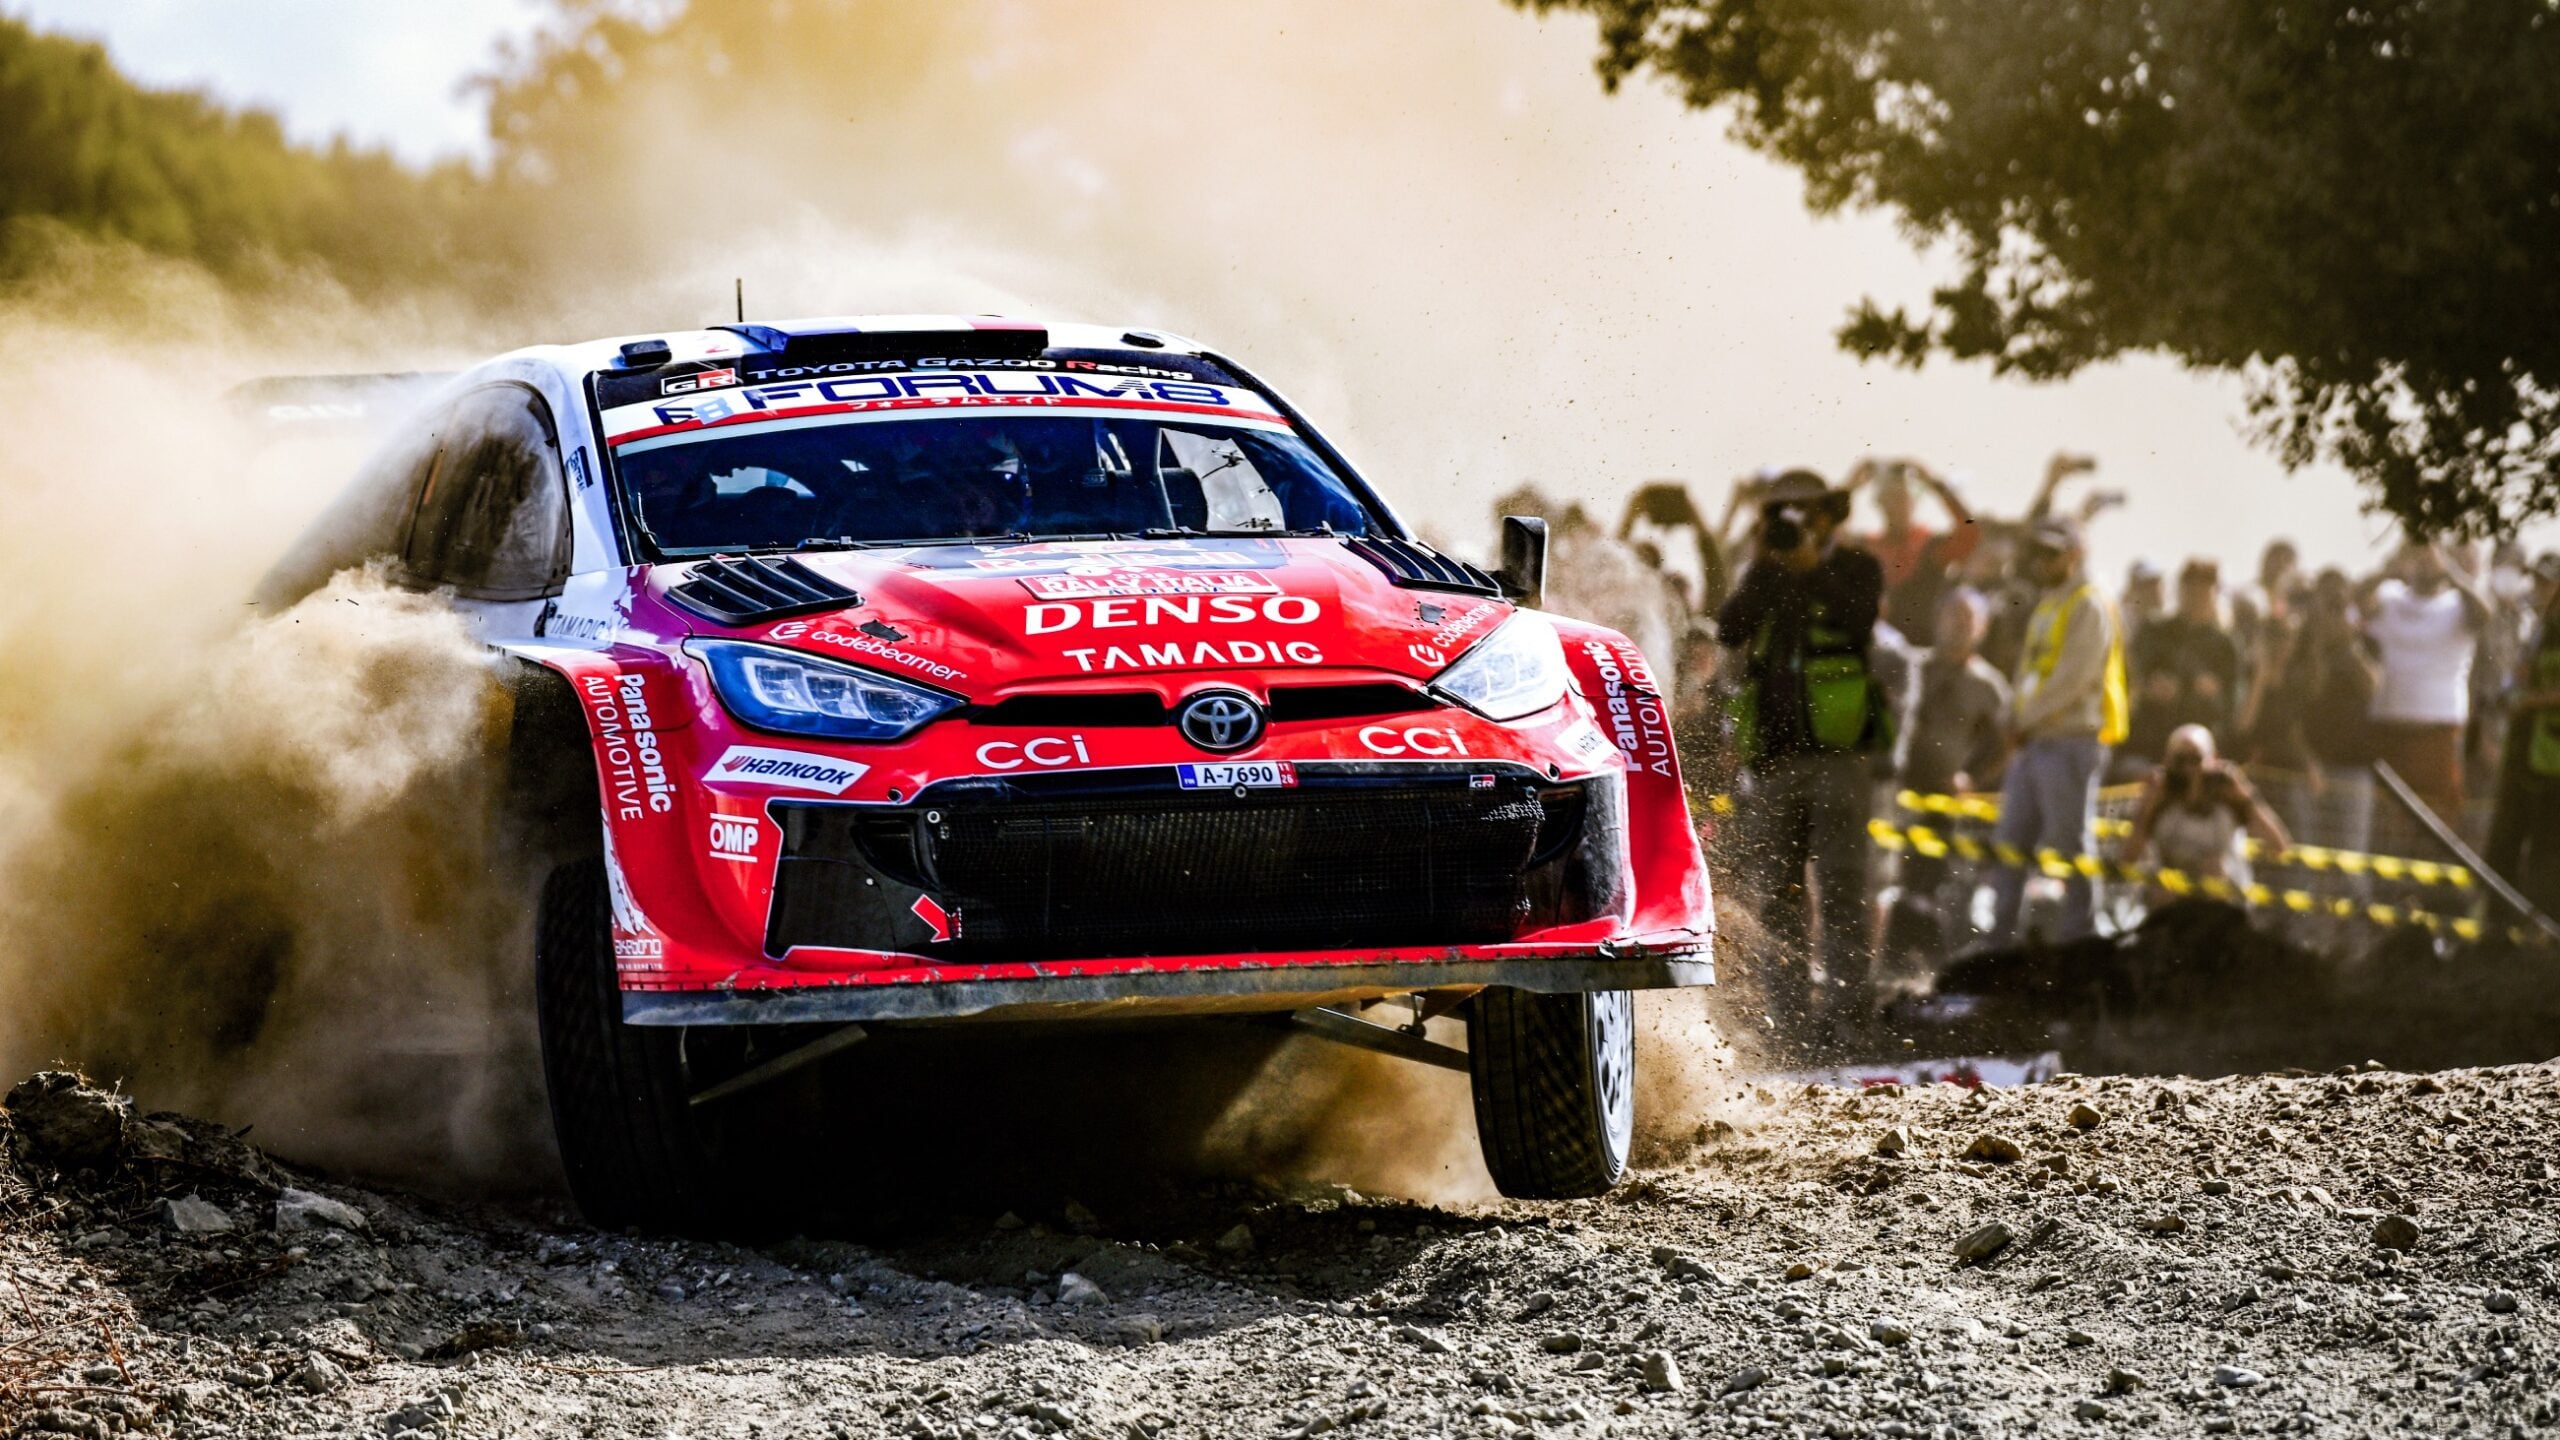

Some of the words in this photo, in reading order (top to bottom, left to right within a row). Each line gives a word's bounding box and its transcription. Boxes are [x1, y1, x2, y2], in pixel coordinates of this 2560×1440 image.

[664, 372, 735, 394] GR
[747, 360, 906, 380] TOYOTA
[917, 357, 1056, 369] GAZOO
[1066, 360, 1193, 381] Racing
[742, 374, 1230, 409] FORUM8
[848, 396, 1062, 410] フォーラムエイド
[1041, 578, 1140, 594] RALLY
[1151, 572, 1258, 590] ITALIA
[551, 614, 606, 640] TAMADIC
[1023, 596, 1321, 635] DENSO
[1432, 602, 1498, 647] codebeamer
[1063, 641, 1323, 671] TAMADIC
[1582, 640, 1642, 772] Panasonic
[1609, 640, 1671, 777] AUTOMOTIVE
[581, 676, 643, 821] AUTOMOTIVE
[613, 674, 676, 813] Panasonic
[1203, 766, 1273, 783] A-7690
[710, 821, 759, 853] OMP
